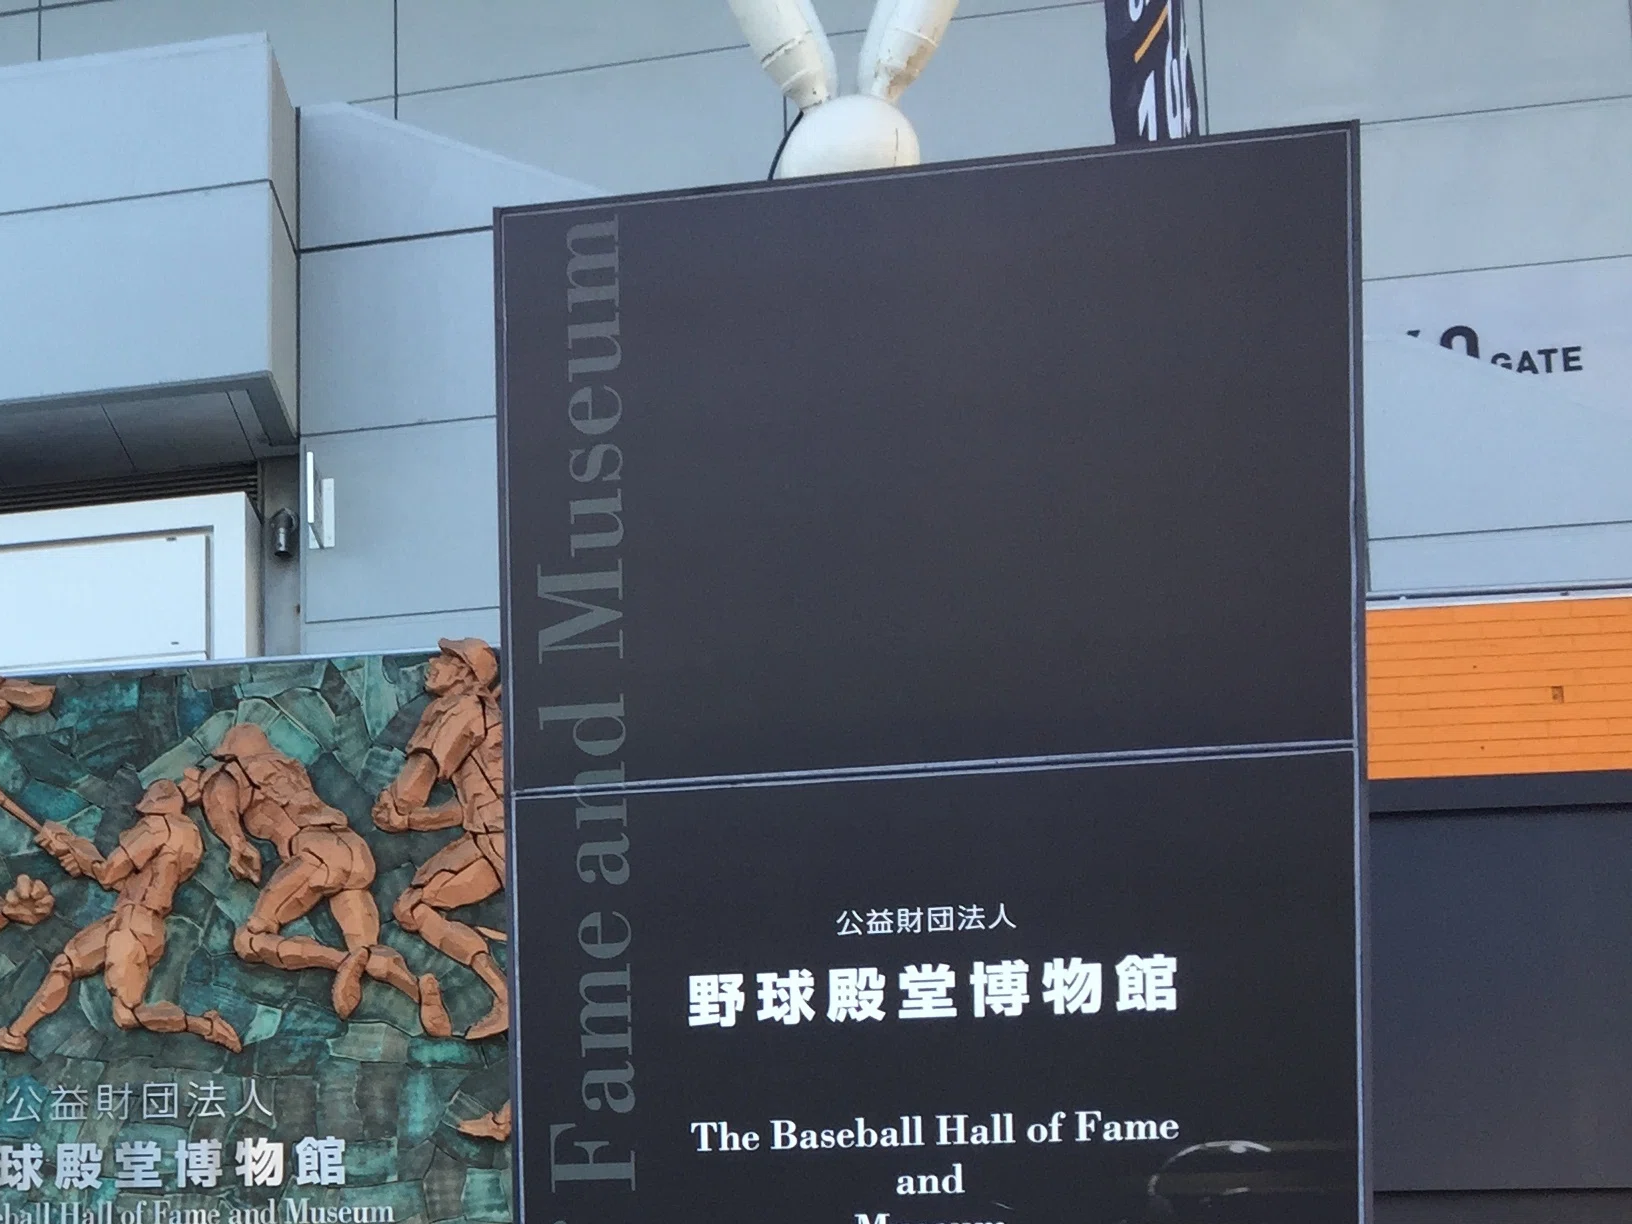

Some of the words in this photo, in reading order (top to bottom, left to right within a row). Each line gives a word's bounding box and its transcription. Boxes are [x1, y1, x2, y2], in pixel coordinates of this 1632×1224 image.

[1490, 346, 1583, 375] GATE
[537, 214, 625, 664] Museum
[539, 694, 631, 886] and
[835, 903, 1017, 936] 公益財団法人
[687, 954, 1179, 1028] 野球殿堂博物館
[549, 911, 636, 1194] Fame
[5, 1079, 274, 1123] 公益財団法人
[691, 1122, 760, 1152] The
[770, 1117, 925, 1151] Baseball
[936, 1113, 1015, 1146] Hall
[1027, 1112, 1066, 1143] of
[1075, 1110, 1180, 1142] Fame
[896, 1164, 965, 1195] and
[229, 1201, 280, 1224] and
[285, 1200, 395, 1224] Museum
